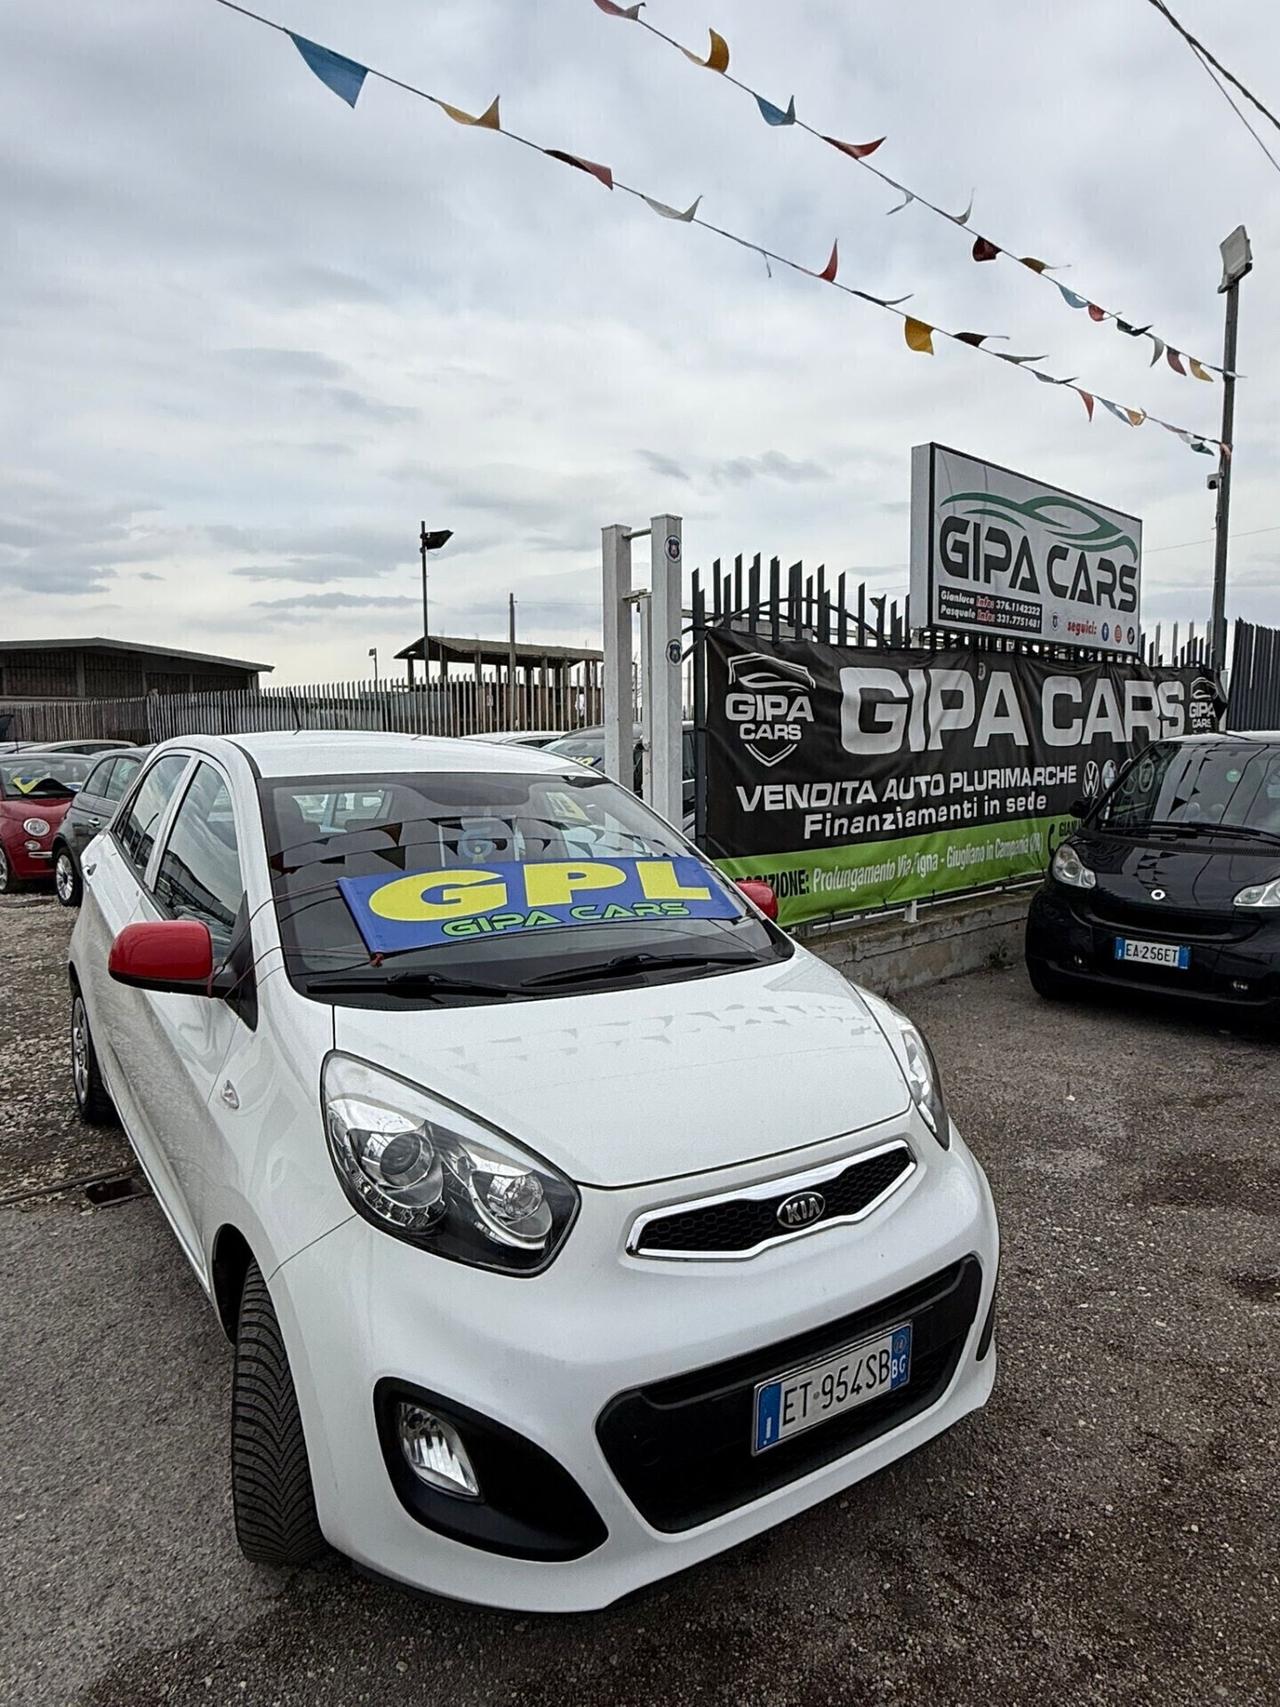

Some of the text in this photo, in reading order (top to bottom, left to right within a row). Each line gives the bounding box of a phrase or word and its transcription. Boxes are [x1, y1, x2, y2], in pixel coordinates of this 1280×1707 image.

[939, 515, 1138, 613] GIPA CARS
[940, 590, 975, 605] Gianluca
[940, 604, 976, 619] Pasquale
[1067, 620, 1097, 636] seguici:
[725, 692, 814, 722] GIPA
[839, 666, 1185, 755] GIPA CARS
[1188, 701, 1216, 718] GIPA
[739, 723, 802, 741] CARS
[1191, 718, 1212, 728] CARS
[736, 764, 1077, 812] VENDITA AUTO PLURIMARCHE
[803, 791, 1047, 840] Finanziamenti in sede
[813, 858, 895, 893] Prolungamento
[947, 843, 985, 870] Giugliano
[986, 839, 994, 861] in
[369, 860, 712, 922] GPL
[442, 900, 691, 938] GIPA CARS
[785, 1196, 820, 1223] KIA
[891, 1354, 907, 1379] BG
